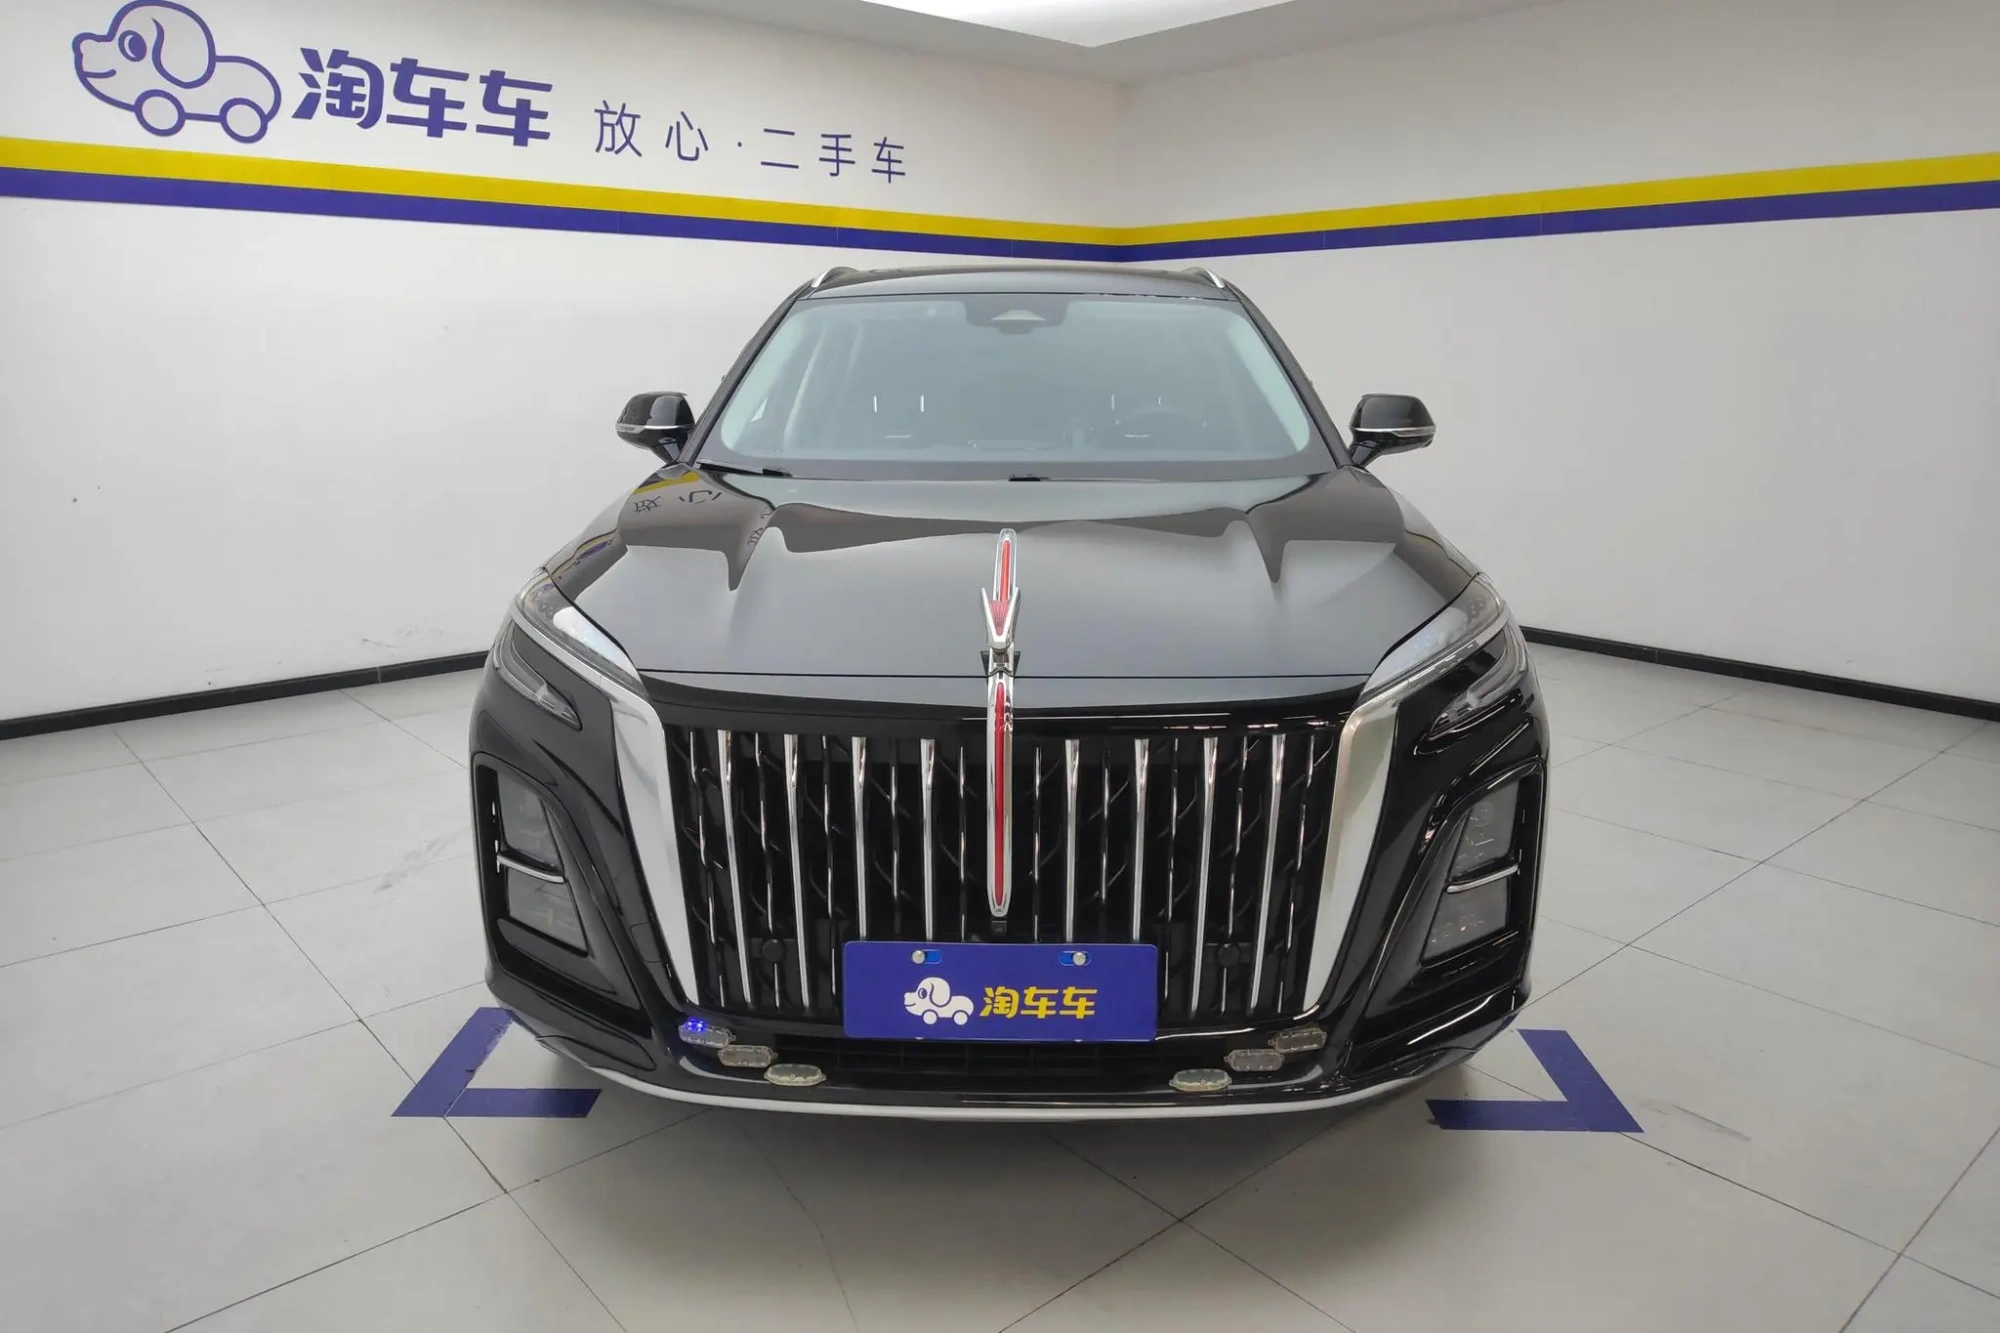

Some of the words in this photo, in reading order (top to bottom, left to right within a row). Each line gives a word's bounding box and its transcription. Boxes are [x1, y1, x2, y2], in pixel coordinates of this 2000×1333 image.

[292, 48, 554, 147] 淘车车
[979, 985, 1098, 1020] 淘车车
